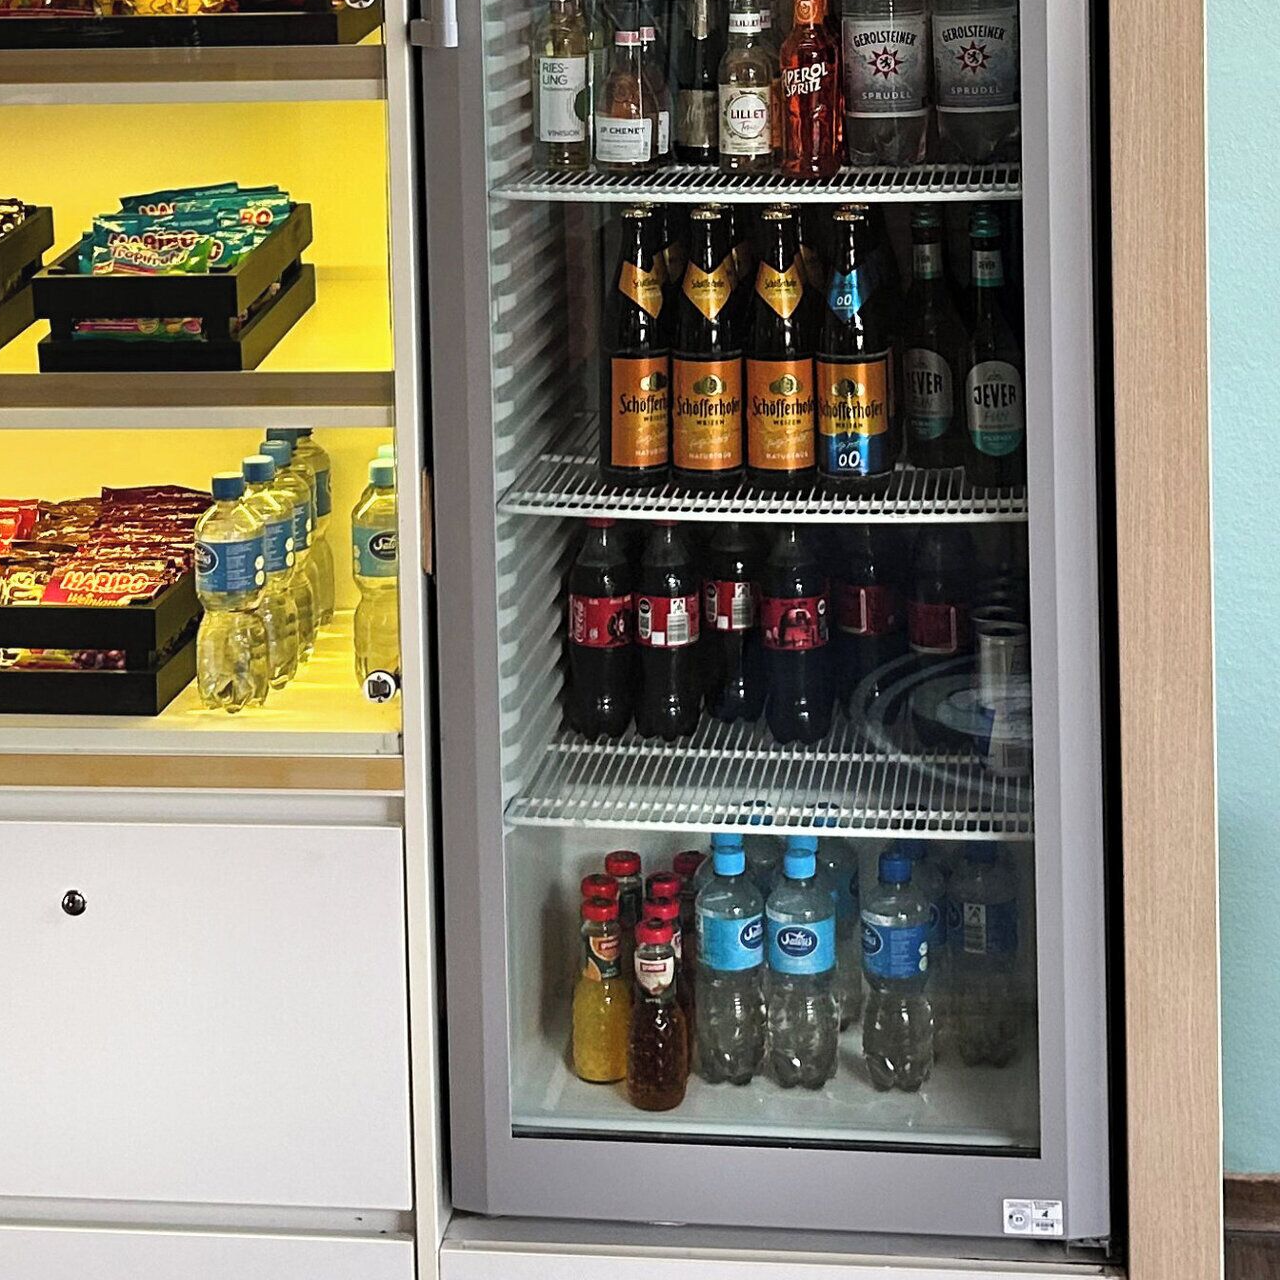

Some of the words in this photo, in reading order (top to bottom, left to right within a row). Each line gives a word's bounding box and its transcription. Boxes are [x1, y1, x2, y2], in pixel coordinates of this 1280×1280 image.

[853, 30, 917, 48] GEROLSTEINER
[942, 24, 1005, 43] GEROLSTEINER
[542, 62, 569, 73] RIES-
[861, 91, 912, 100] SPRUDEL
[950, 86, 1001, 95] SPRUDEL
[730, 108, 766, 120] LILLET
[973, 383, 1017, 409] JEVER
